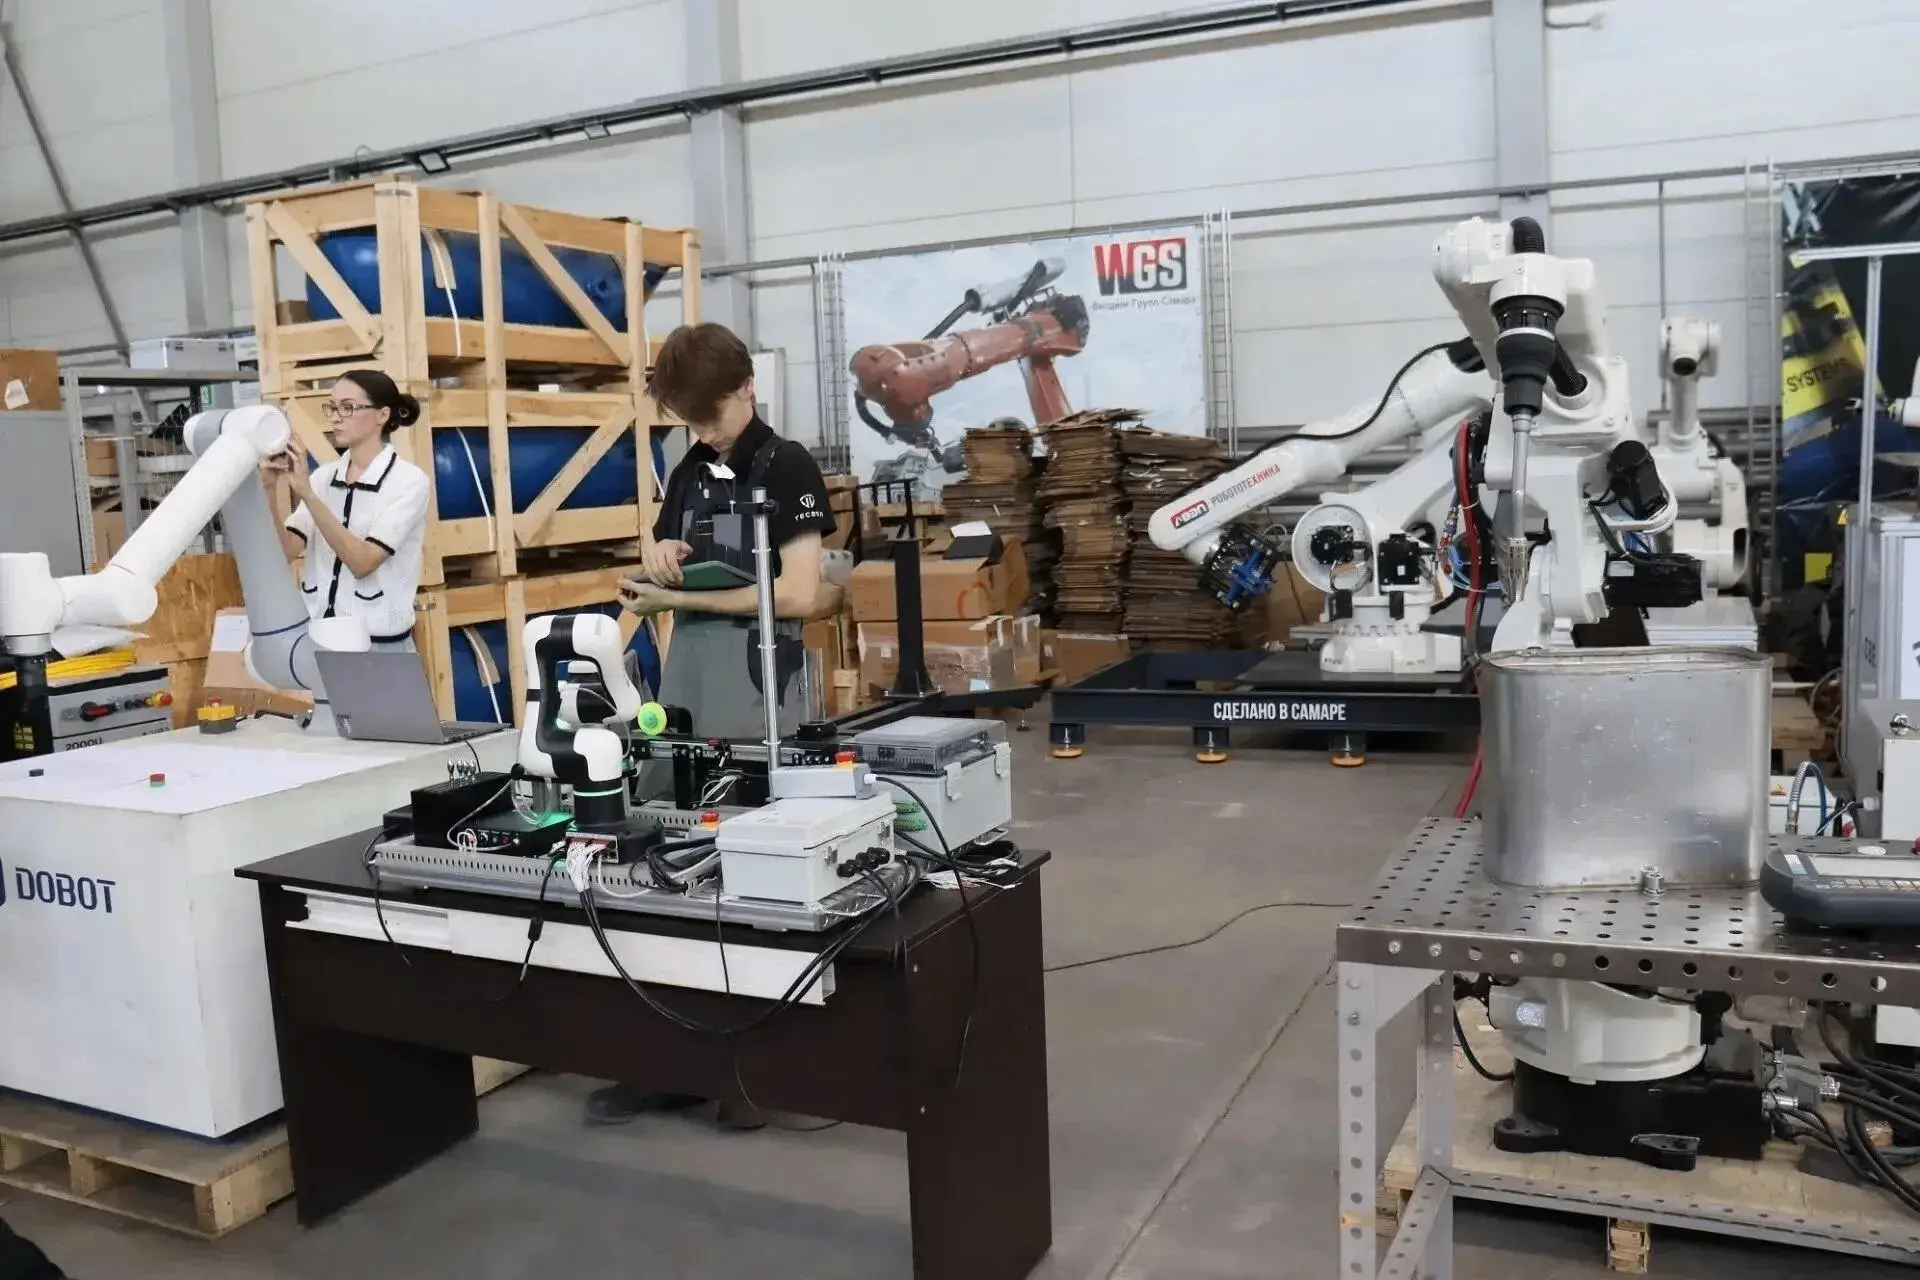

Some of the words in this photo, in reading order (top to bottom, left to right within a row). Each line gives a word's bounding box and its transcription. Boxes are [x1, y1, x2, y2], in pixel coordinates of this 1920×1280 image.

[1094, 239, 1186, 296] WGS
[1211, 464, 1281, 507] РОБОТОТЕХНИКА
[1213, 702, 1276, 720] СДЕЛАНО
[1279, 703, 1288, 719] В
[1291, 703, 1347, 720] САМАРЕ
[15, 866, 116, 914] DOBOT
